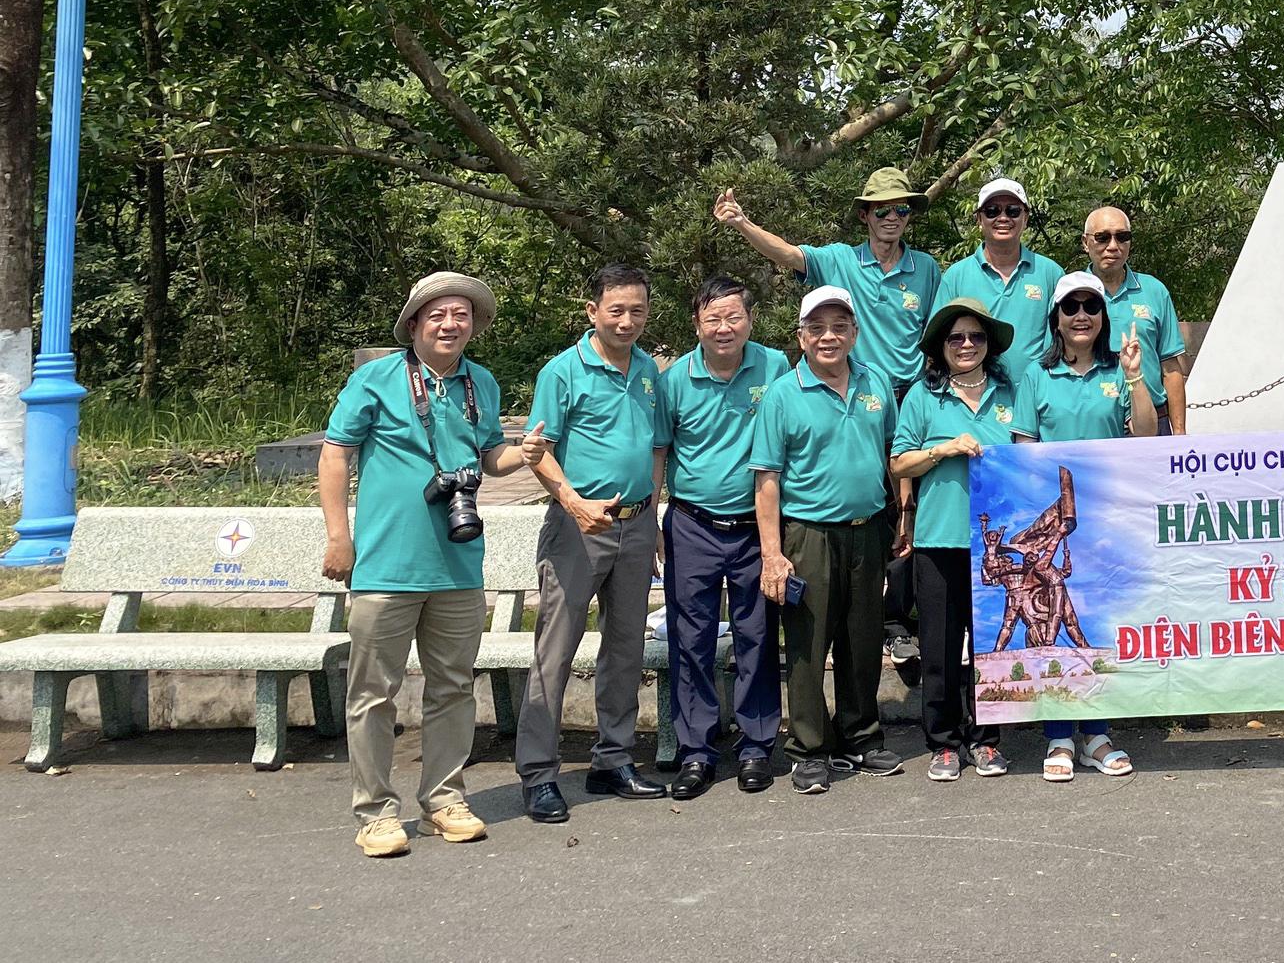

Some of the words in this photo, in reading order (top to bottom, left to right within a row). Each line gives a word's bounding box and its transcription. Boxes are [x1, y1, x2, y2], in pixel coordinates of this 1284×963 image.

[1169, 448, 1207, 478] HỘI
[1213, 449, 1256, 476] CỰU
[1155, 492, 1282, 544] HÀNH
[213, 563, 243, 573] EVN
[1227, 553, 1277, 601] KỶ
[1116, 616, 1201, 667] ĐIỆN
